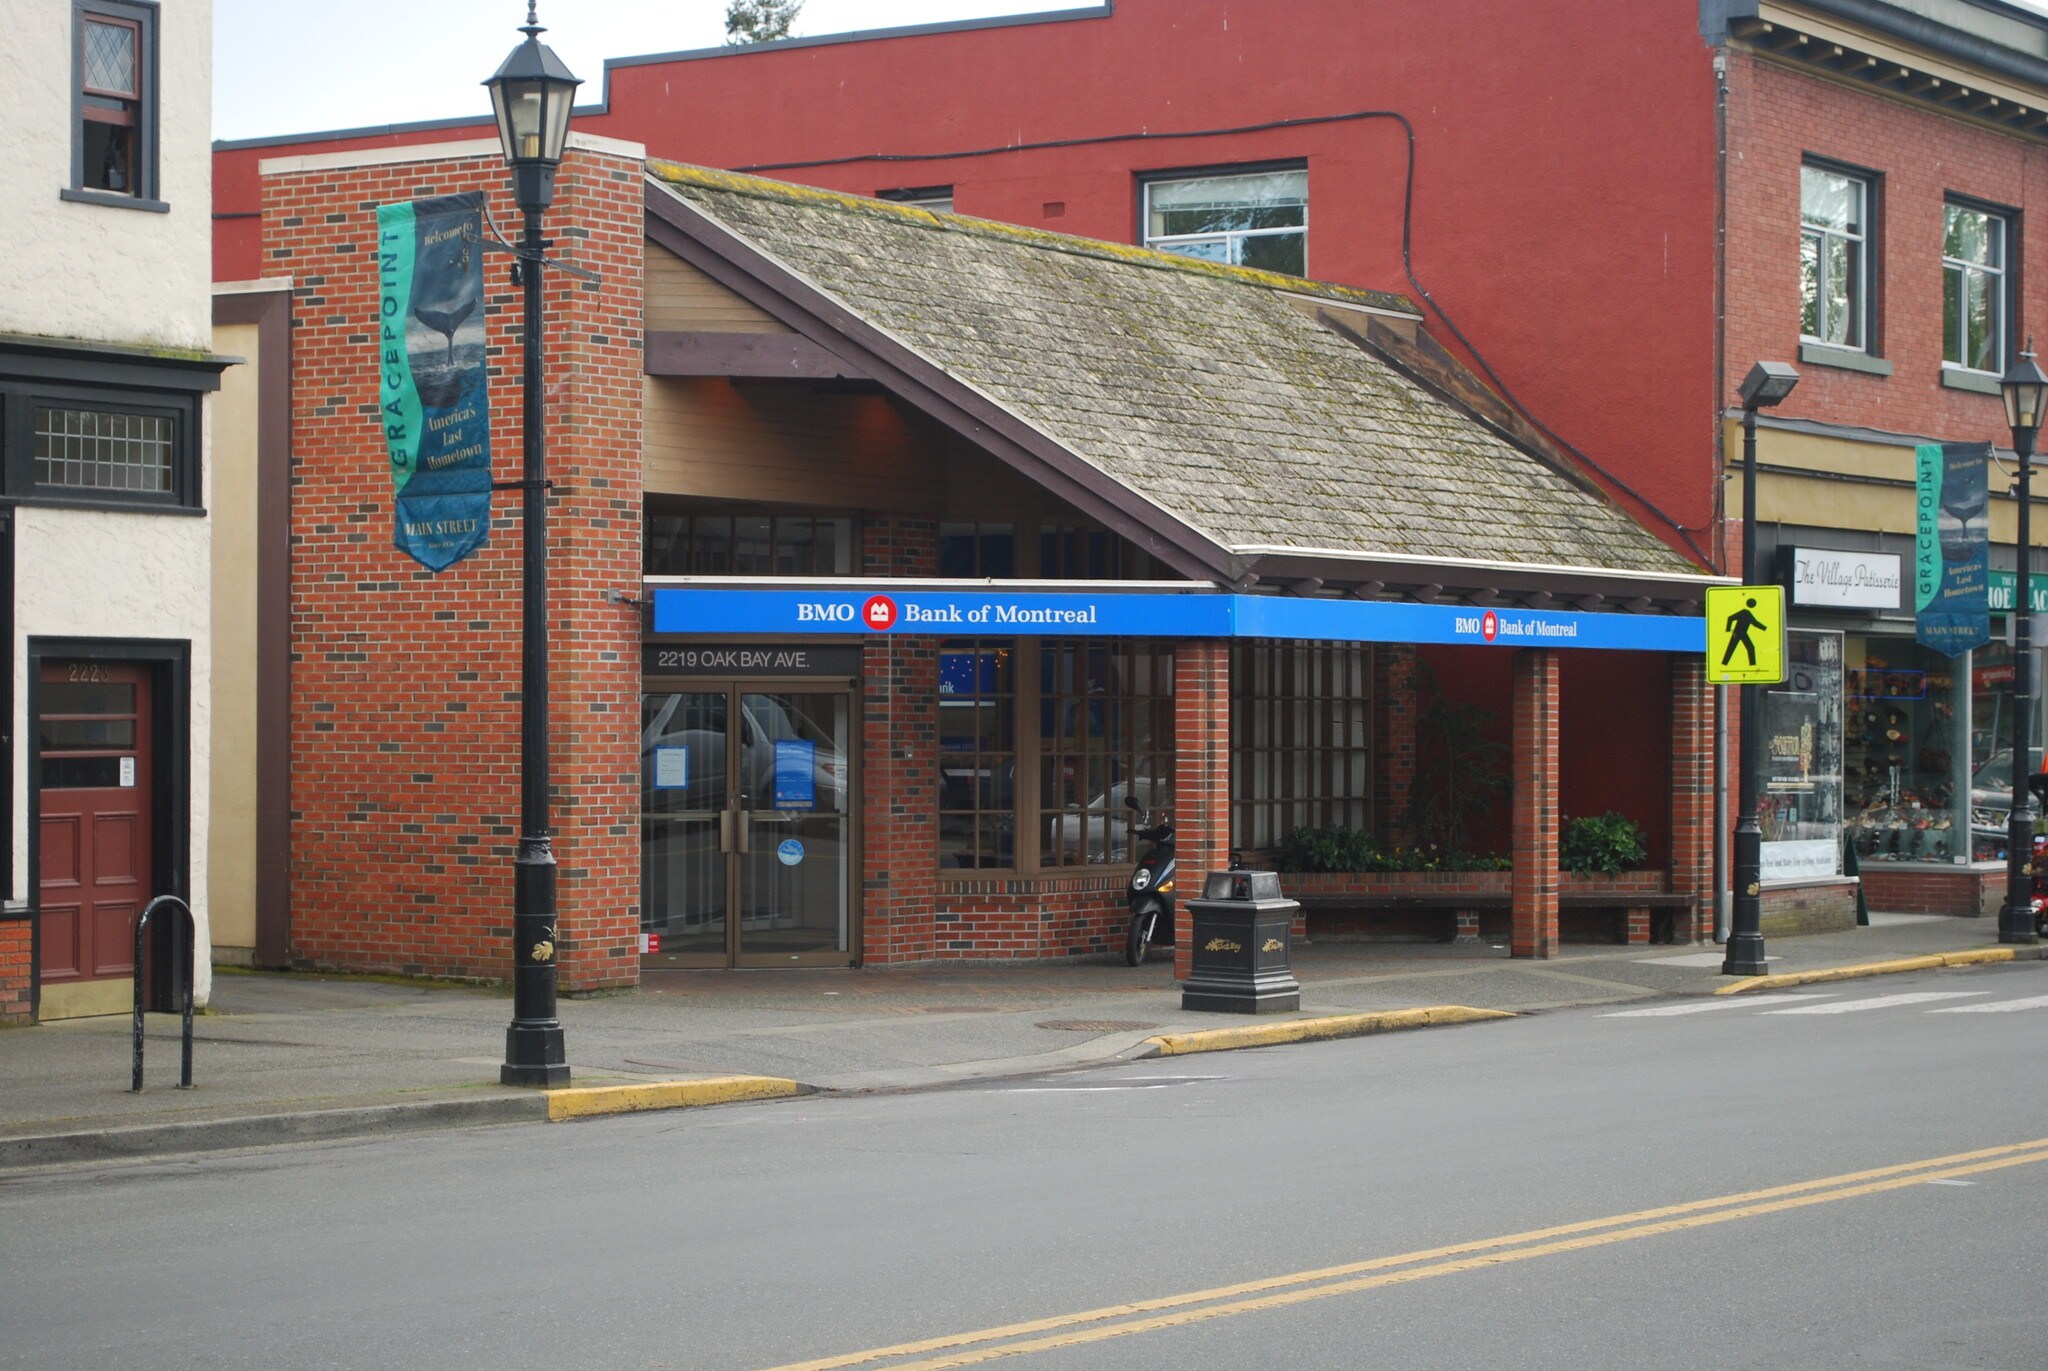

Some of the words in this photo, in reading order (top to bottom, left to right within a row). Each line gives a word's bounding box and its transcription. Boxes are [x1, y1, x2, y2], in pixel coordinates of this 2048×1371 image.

[424, 226, 461, 247] Welcome
[381, 231, 408, 467] GRACEPOINT
[427, 403, 476, 433] America's
[442, 429, 463, 447] Last
[427, 443, 482, 470] Hometown
[1949, 459, 1975, 471] Welcome
[405, 522, 433, 536] MAIN
[436, 518, 478, 535] STREET
[1919, 458, 1932, 595] GRACEPOINT
[1795, 560, 1814, 585] The
[1816, 560, 1853, 596] Village
[1854, 563, 1899, 589] Patisserie
[1948, 562, 1982, 576] America's
[1956, 574, 1972, 585] Last
[1944, 584, 1985, 598] Hometown
[797, 603, 855, 621] BMO
[904, 603, 963, 622] Bank
[967, 605, 991, 623] of
[995, 605, 1097, 623] Montreal
[1455, 617, 1480, 634] BMO
[1500, 618, 1523, 635] Bank
[1525, 620, 1536, 636] of
[1536, 621, 1578, 637] Montreal
[1924, 626, 1948, 636] MAIN
[1949, 626, 1979, 636] STREET
[658, 651, 697, 667] 2219
[701, 651, 738, 667] OAK
[740, 651, 772, 667] BAY
[774, 652, 810, 668] AVE.
[68, 663, 110, 682] 2223
